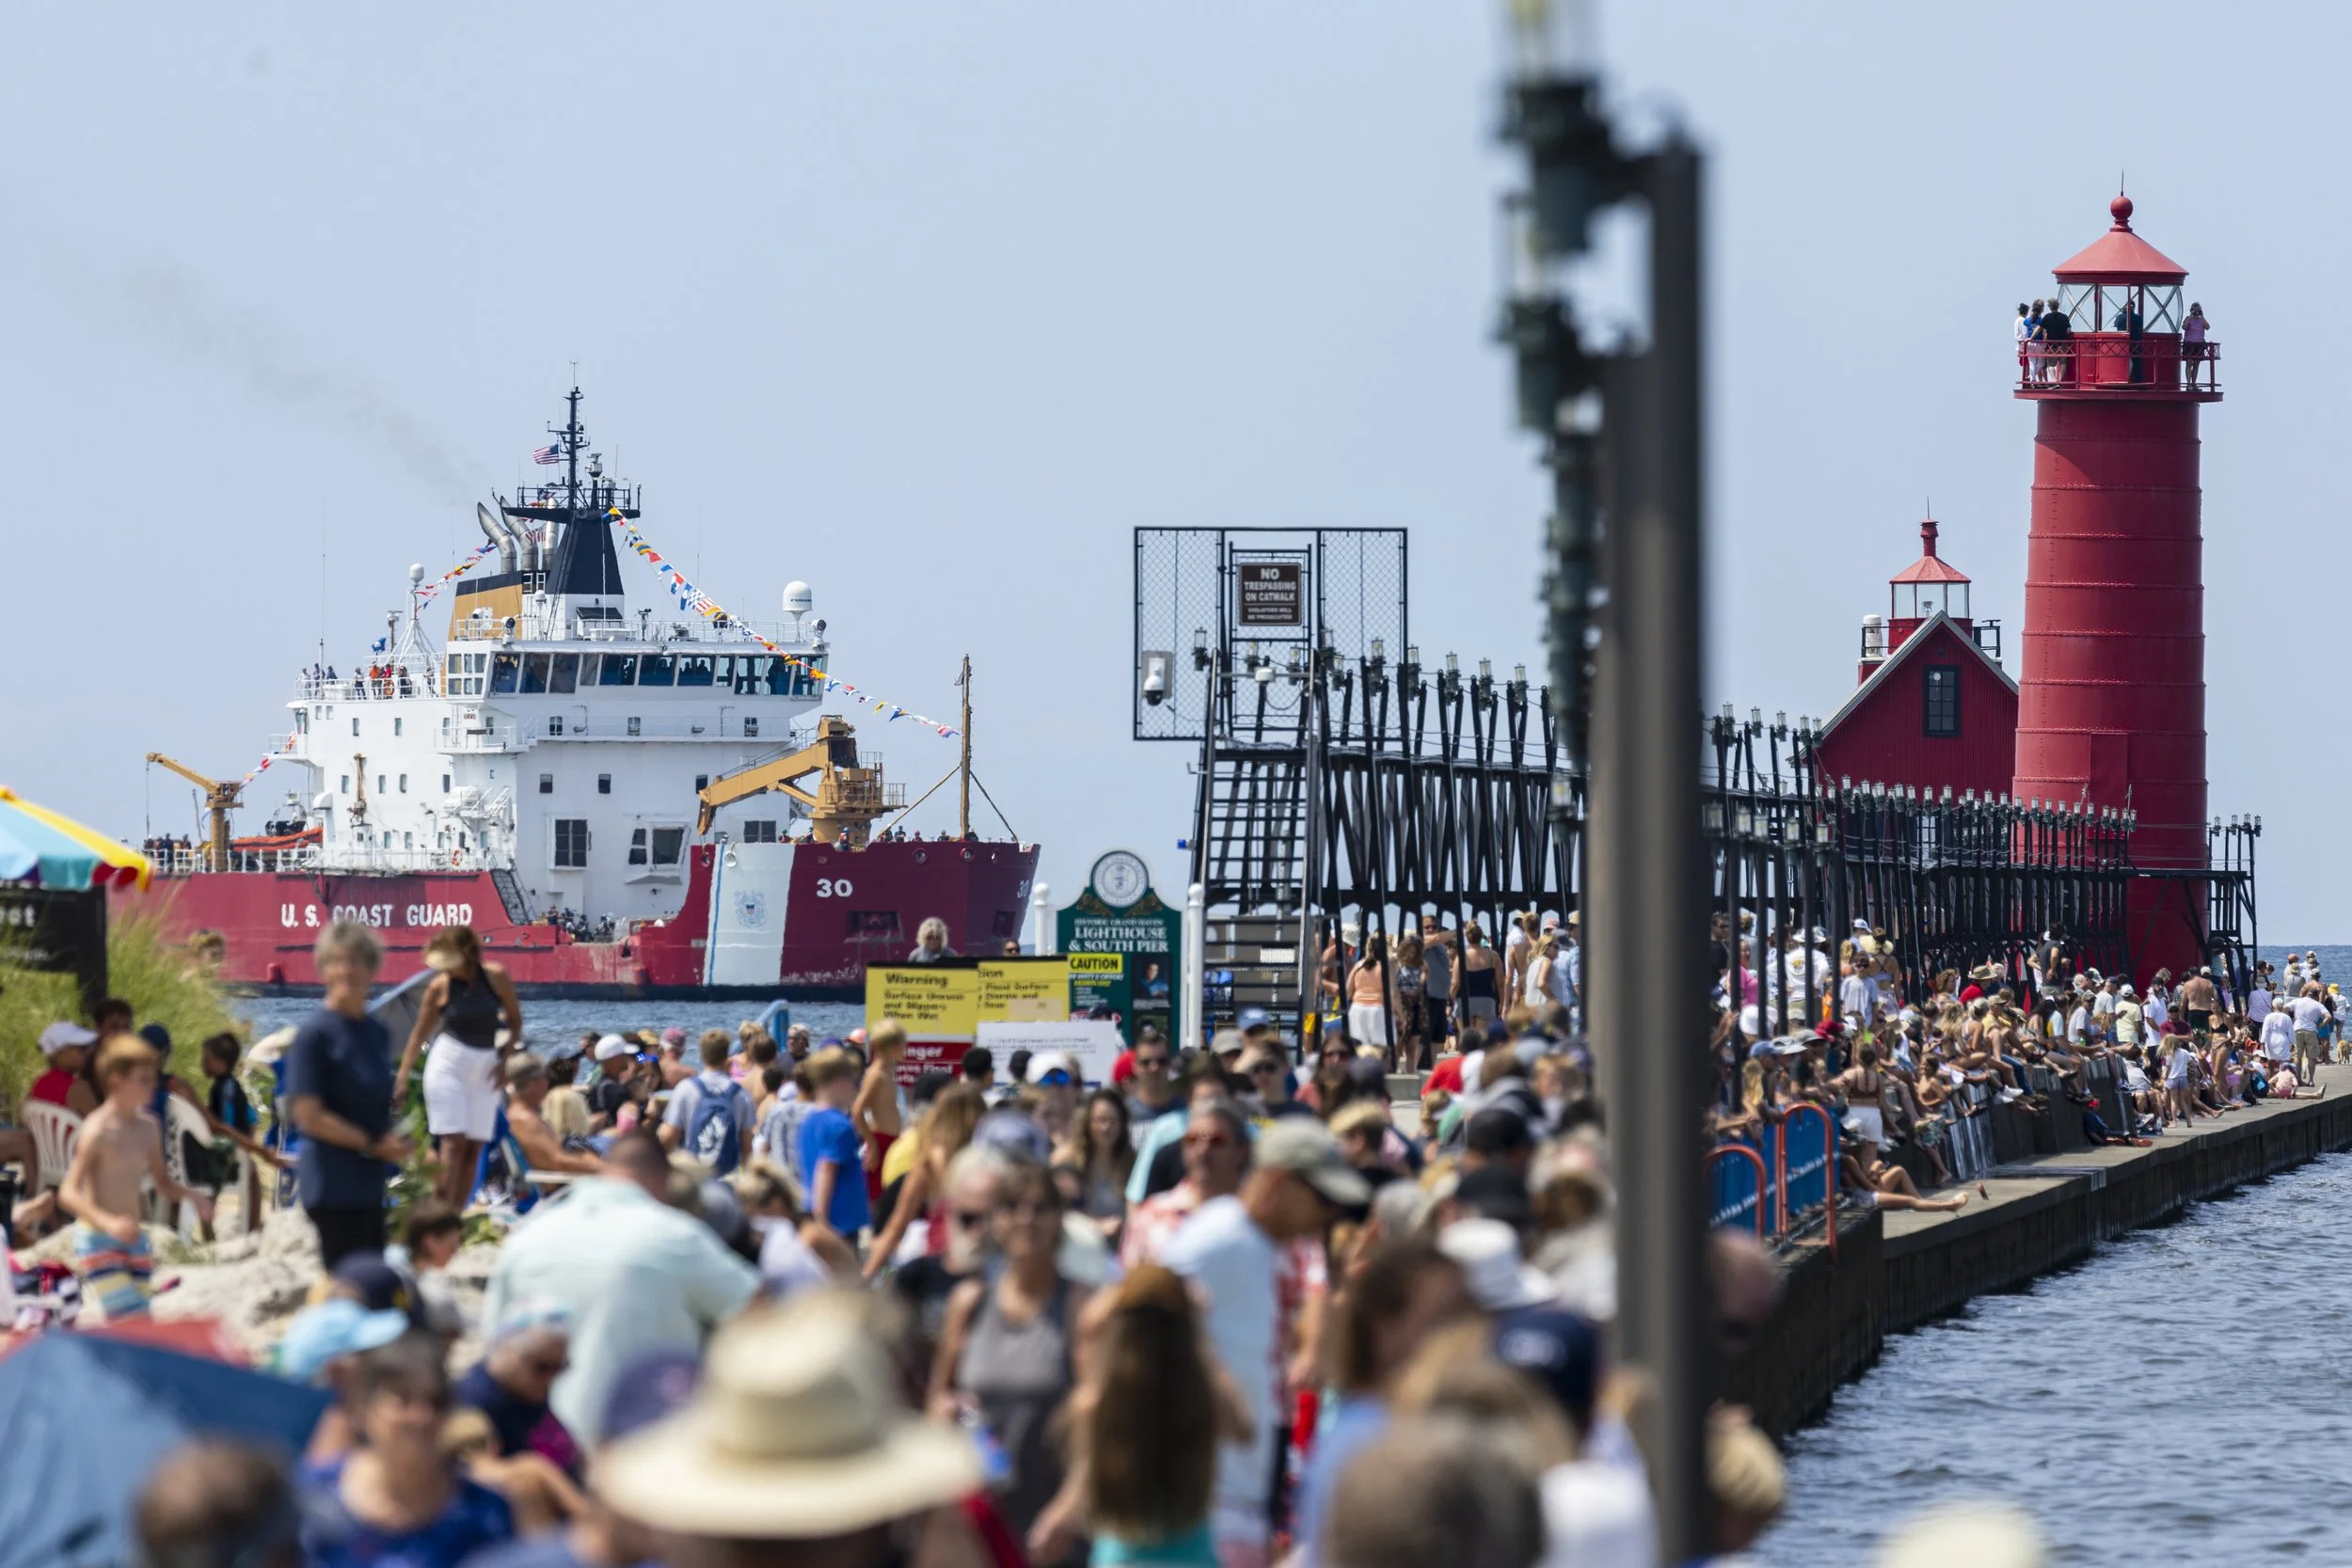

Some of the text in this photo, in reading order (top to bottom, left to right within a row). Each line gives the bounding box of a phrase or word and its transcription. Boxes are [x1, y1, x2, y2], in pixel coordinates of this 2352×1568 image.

[1261, 568, 1279, 579] NO
[1244, 581, 1296, 591] TRESPASSING
[1245, 593, 1295, 601] ON CATWALK
[817, 879, 852, 898] 30
[333, 905, 393, 927] COAST
[406, 903, 473, 927] GUARD
[1074, 927, 1167, 939] LIGHTHOUSE
[1069, 941, 1168, 952] & SOUTH PIER
[1070, 958, 1119, 970] CAUTION
[885, 973, 948, 989] Warning
[883, 990, 922, 1000] Surface
[903, 1046, 944, 1061] nger
